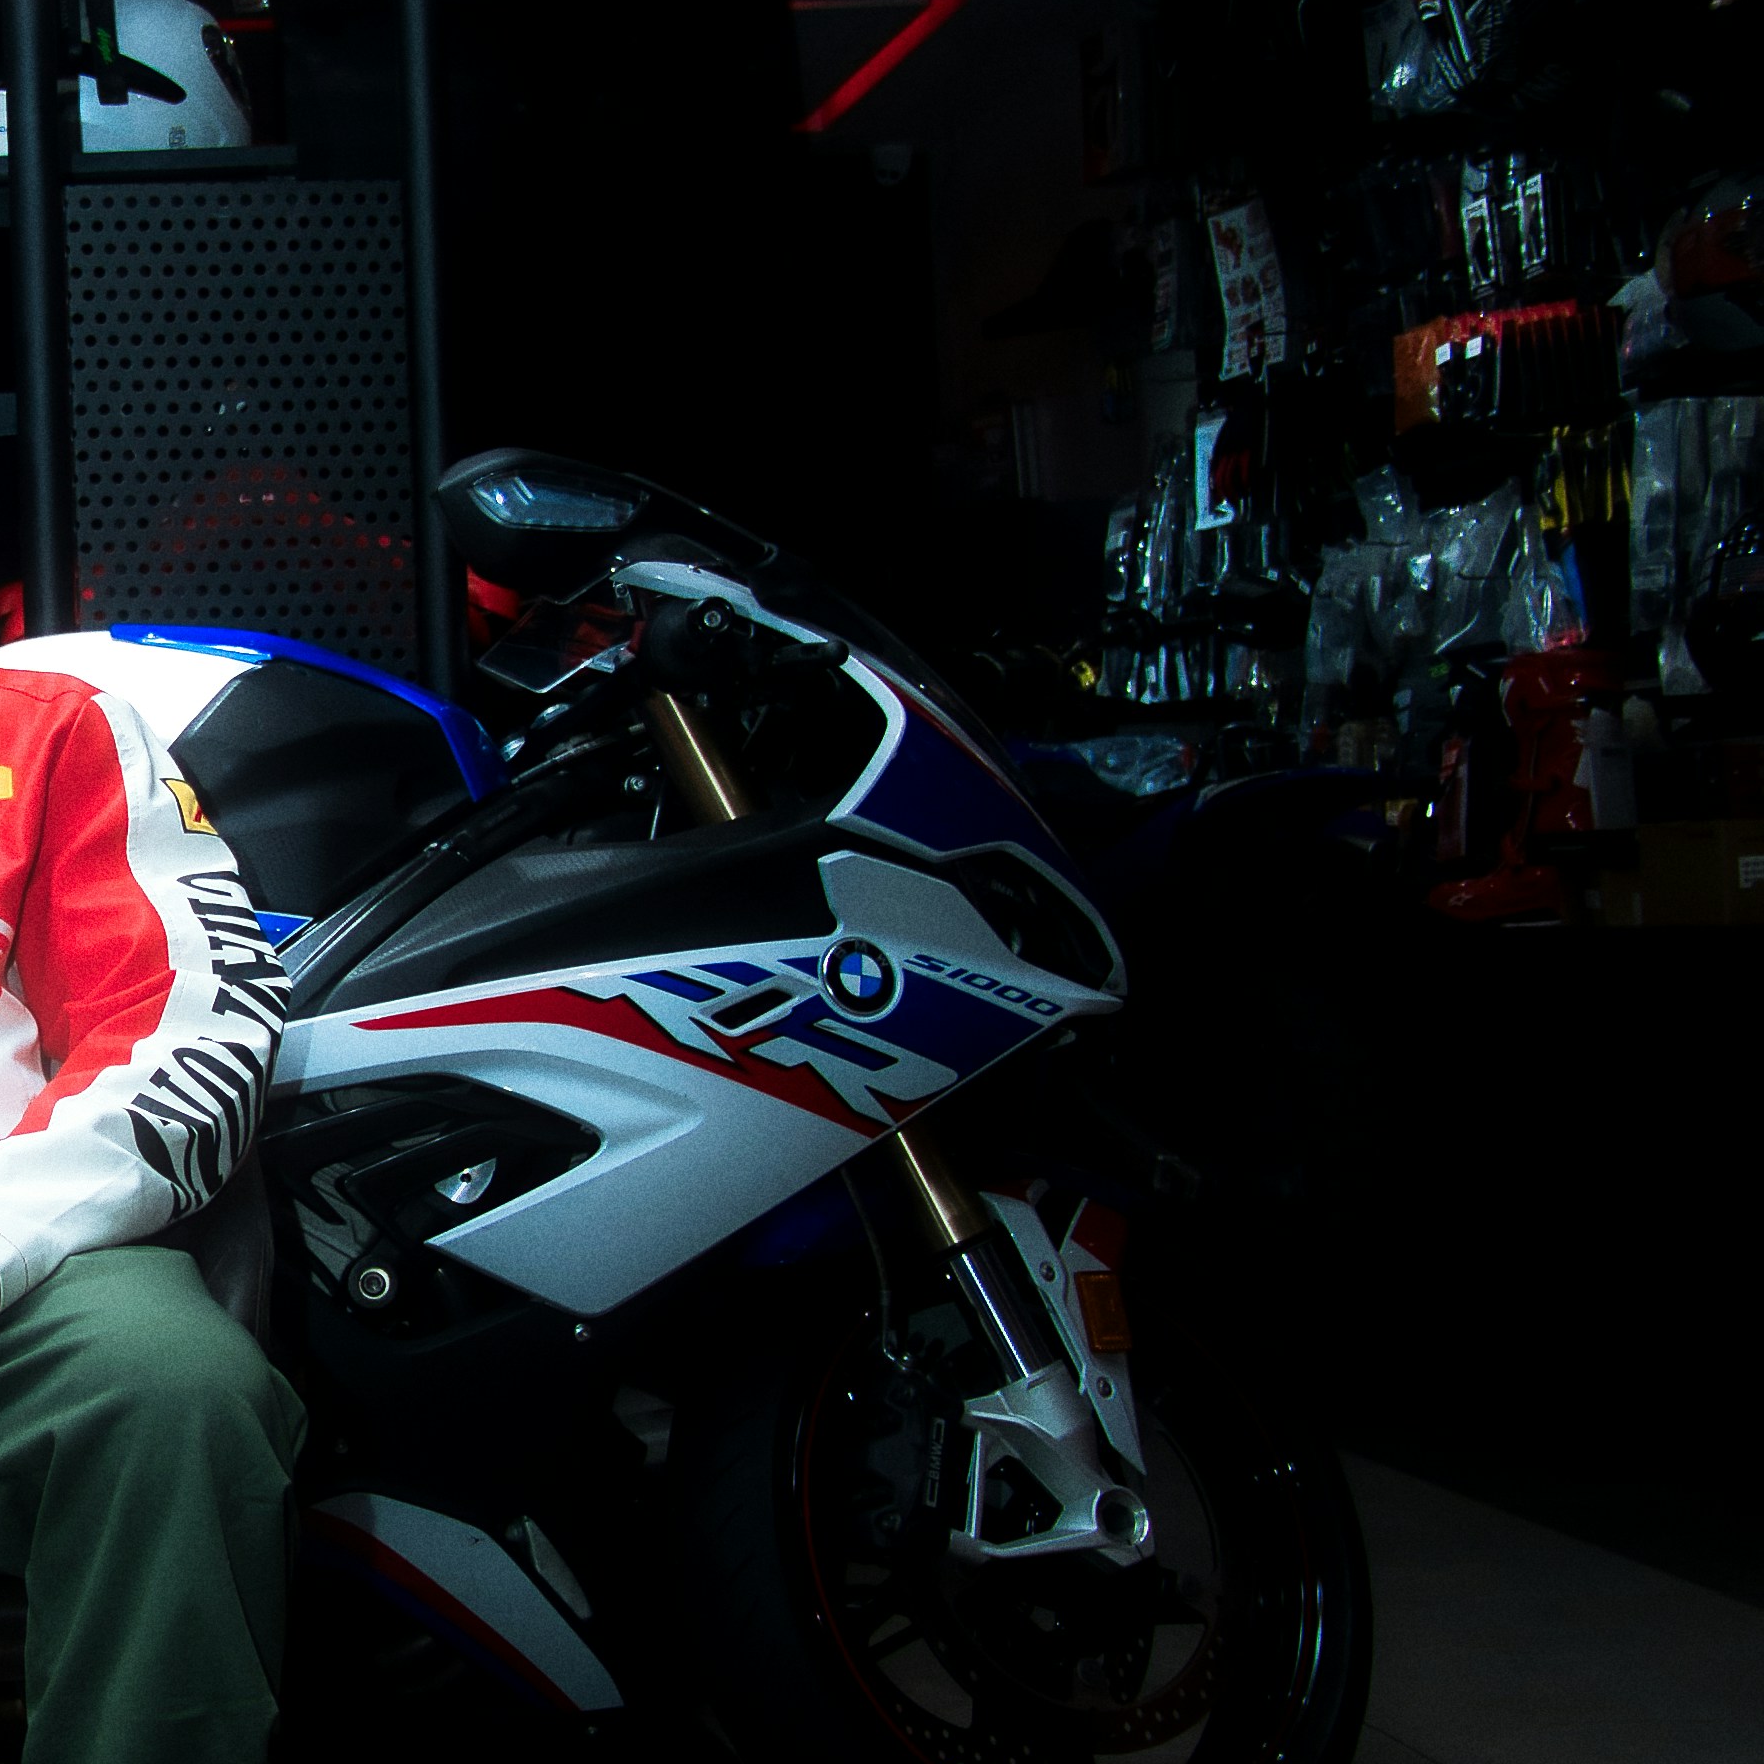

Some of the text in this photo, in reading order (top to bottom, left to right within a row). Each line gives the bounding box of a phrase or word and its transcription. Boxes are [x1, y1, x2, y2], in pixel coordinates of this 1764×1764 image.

[835, 939, 890, 969] BMW
[903, 953, 1064, 1017] S1000
[926, 1440, 943, 1482] BMW
